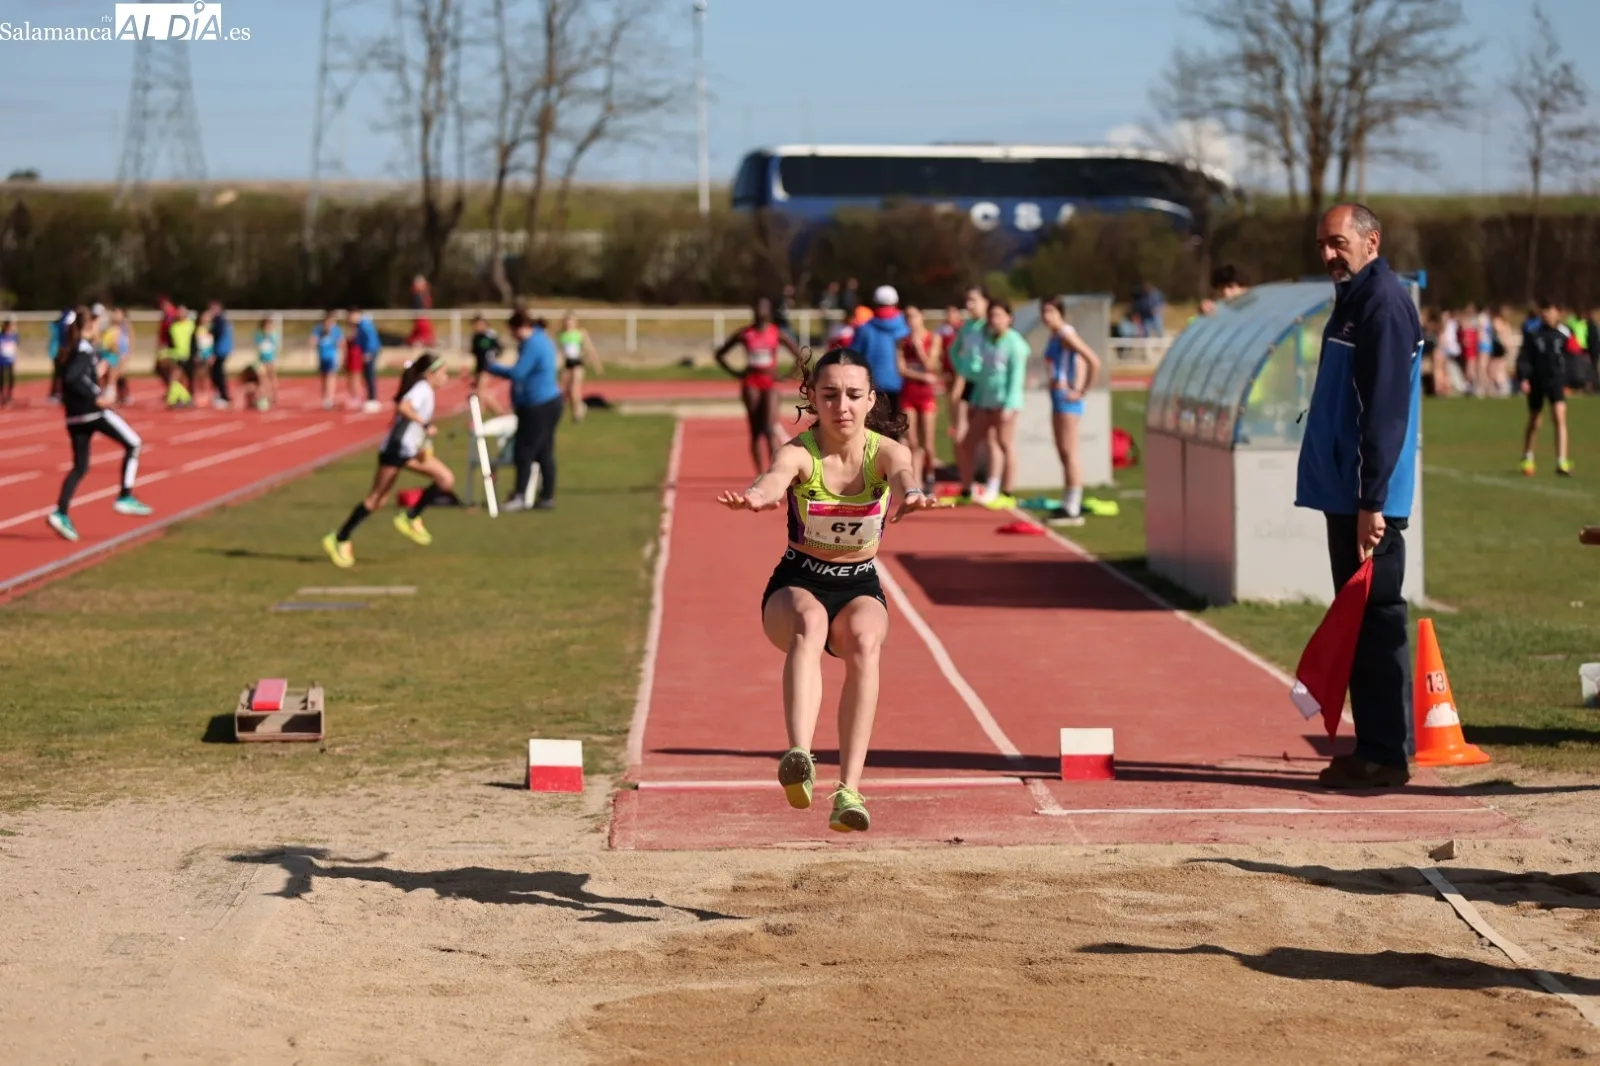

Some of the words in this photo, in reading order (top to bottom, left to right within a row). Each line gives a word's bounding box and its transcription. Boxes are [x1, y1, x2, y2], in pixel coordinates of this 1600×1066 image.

[831, 522, 863, 536] 67
[801, 559, 853, 577] NIKE
[1426, 672, 1445, 692] 13
